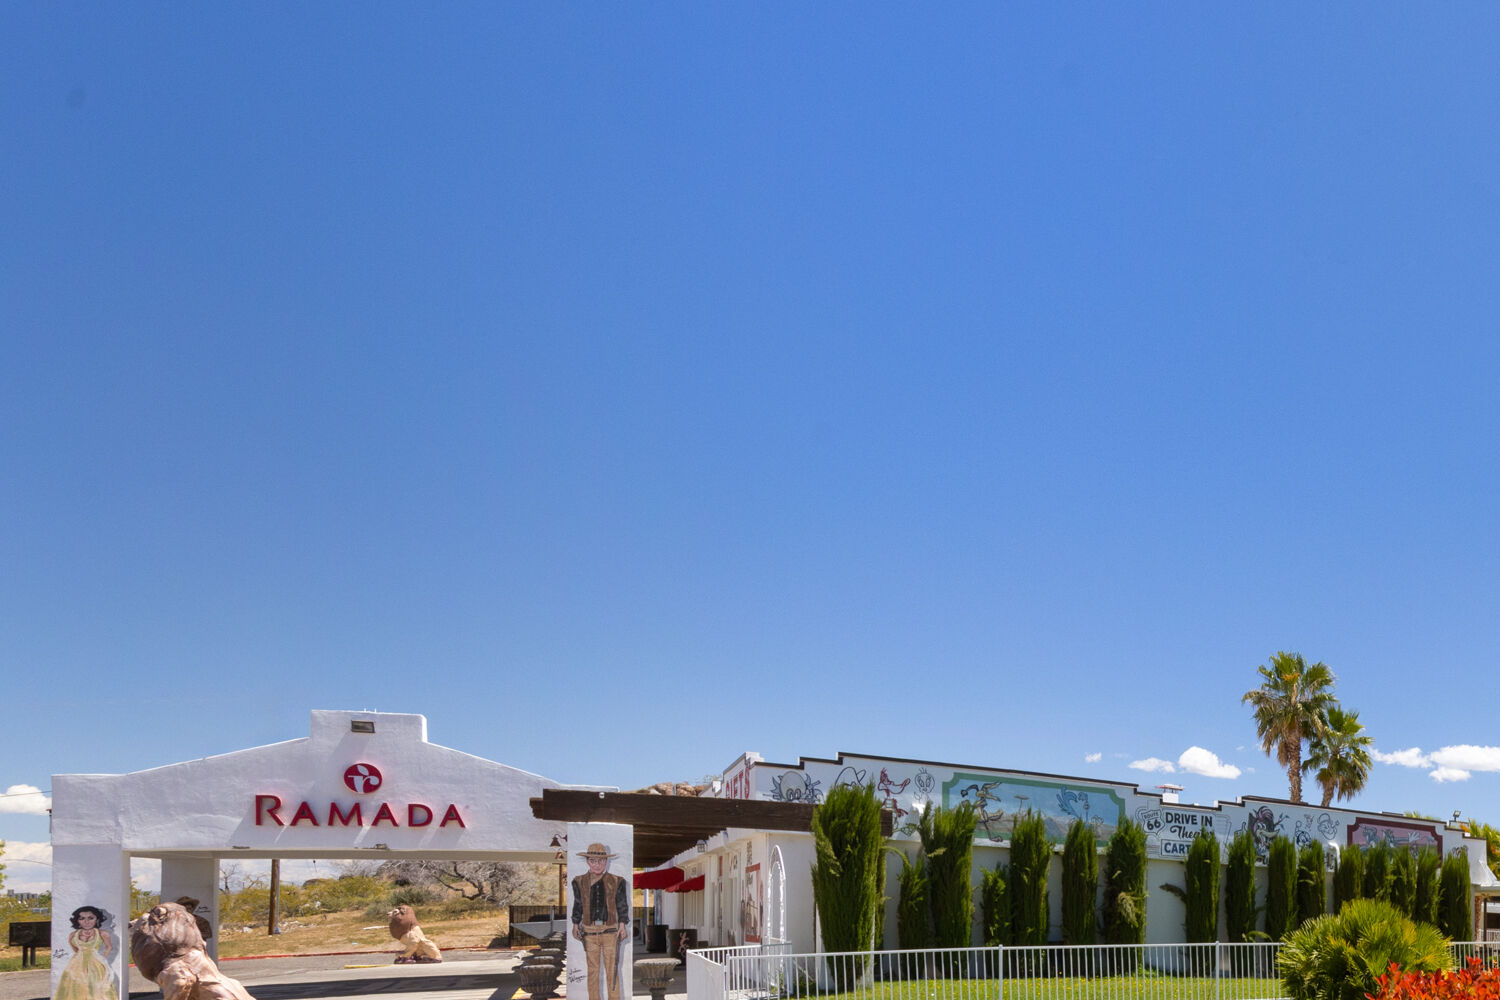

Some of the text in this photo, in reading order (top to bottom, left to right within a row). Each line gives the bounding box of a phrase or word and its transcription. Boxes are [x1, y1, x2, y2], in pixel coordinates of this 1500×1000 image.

[725, 767, 750, 800] GIFTS
[255, 794, 466, 828] RAMADA
[1143, 811, 1159, 820] ROUTE
[1146, 819, 1161, 831] 66
[1165, 812, 1213, 827] DRIVE IN
